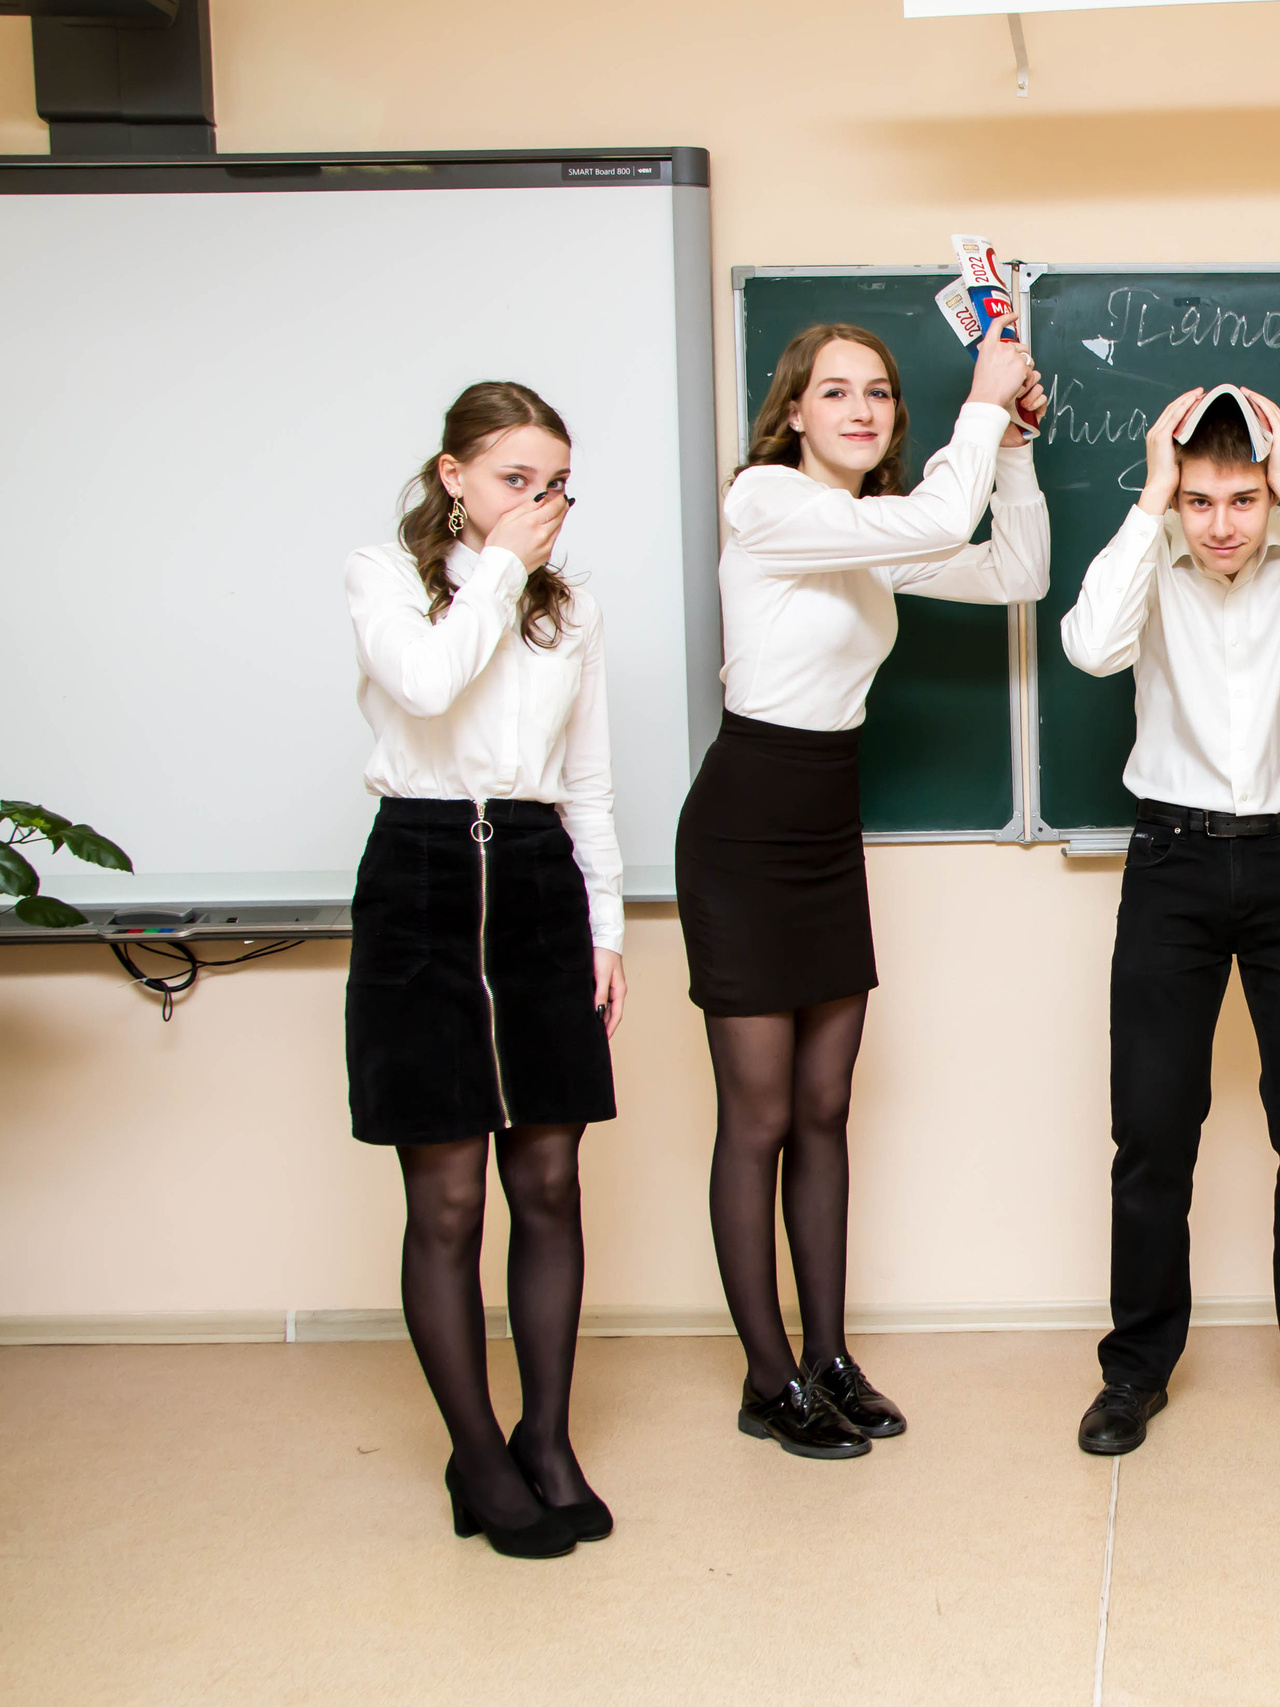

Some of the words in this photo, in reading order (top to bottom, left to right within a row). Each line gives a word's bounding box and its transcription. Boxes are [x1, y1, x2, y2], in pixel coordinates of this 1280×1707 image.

[568, 168, 594, 176] SMART
[595, 168, 615, 176] Board
[617, 167, 631, 175] 800
[968, 256, 989, 283] 2022
[955, 306, 981, 338] 2022
